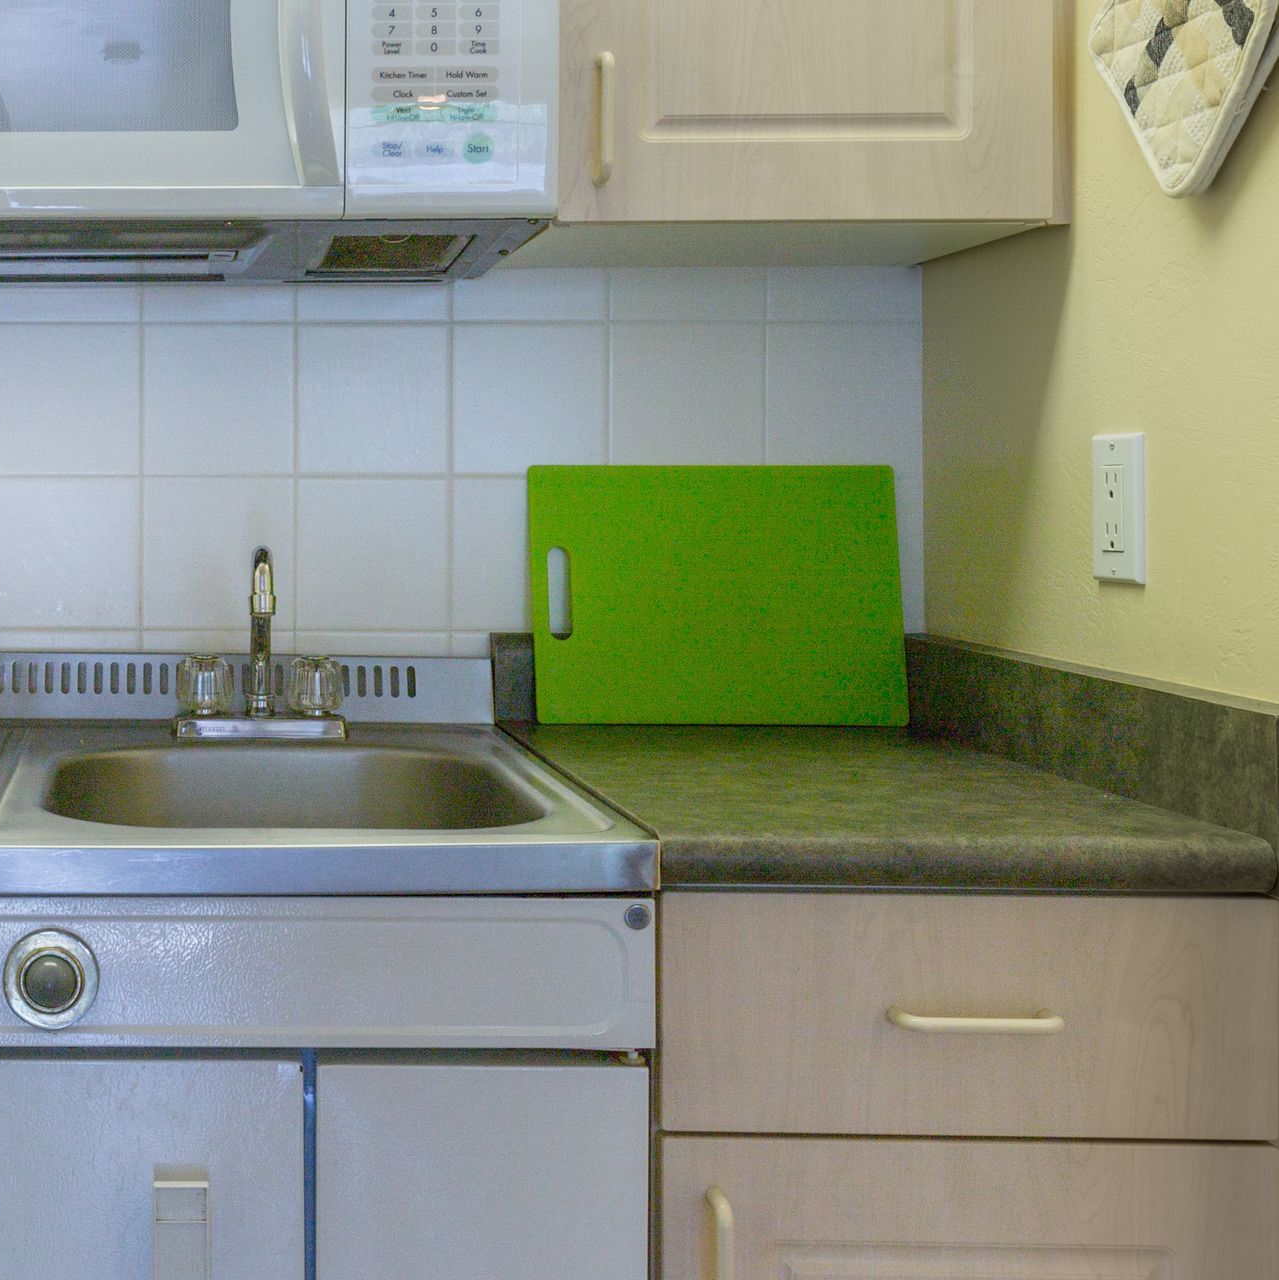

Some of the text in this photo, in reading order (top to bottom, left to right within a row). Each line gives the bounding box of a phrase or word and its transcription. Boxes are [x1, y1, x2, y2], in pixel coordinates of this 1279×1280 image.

[388, 8, 396, 18] 4
[431, 8, 438, 18] 5
[475, 8, 482, 17] 6
[388, 26, 396, 35] 7
[431, 25, 438, 35] 8
[475, 25, 482, 35] 9
[430, 43, 438, 52] 0
[379, 71, 428, 79] Kitchen Timer
[445, 71, 488, 79] Hold Warm
[393, 90, 413, 98] Clock
[446, 90, 487, 98] Custom Set
[396, 106, 411, 114] Vent
[426, 144, 444, 155] Help
[467, 143, 489, 153] Start
[382, 149, 402, 157] Clear
